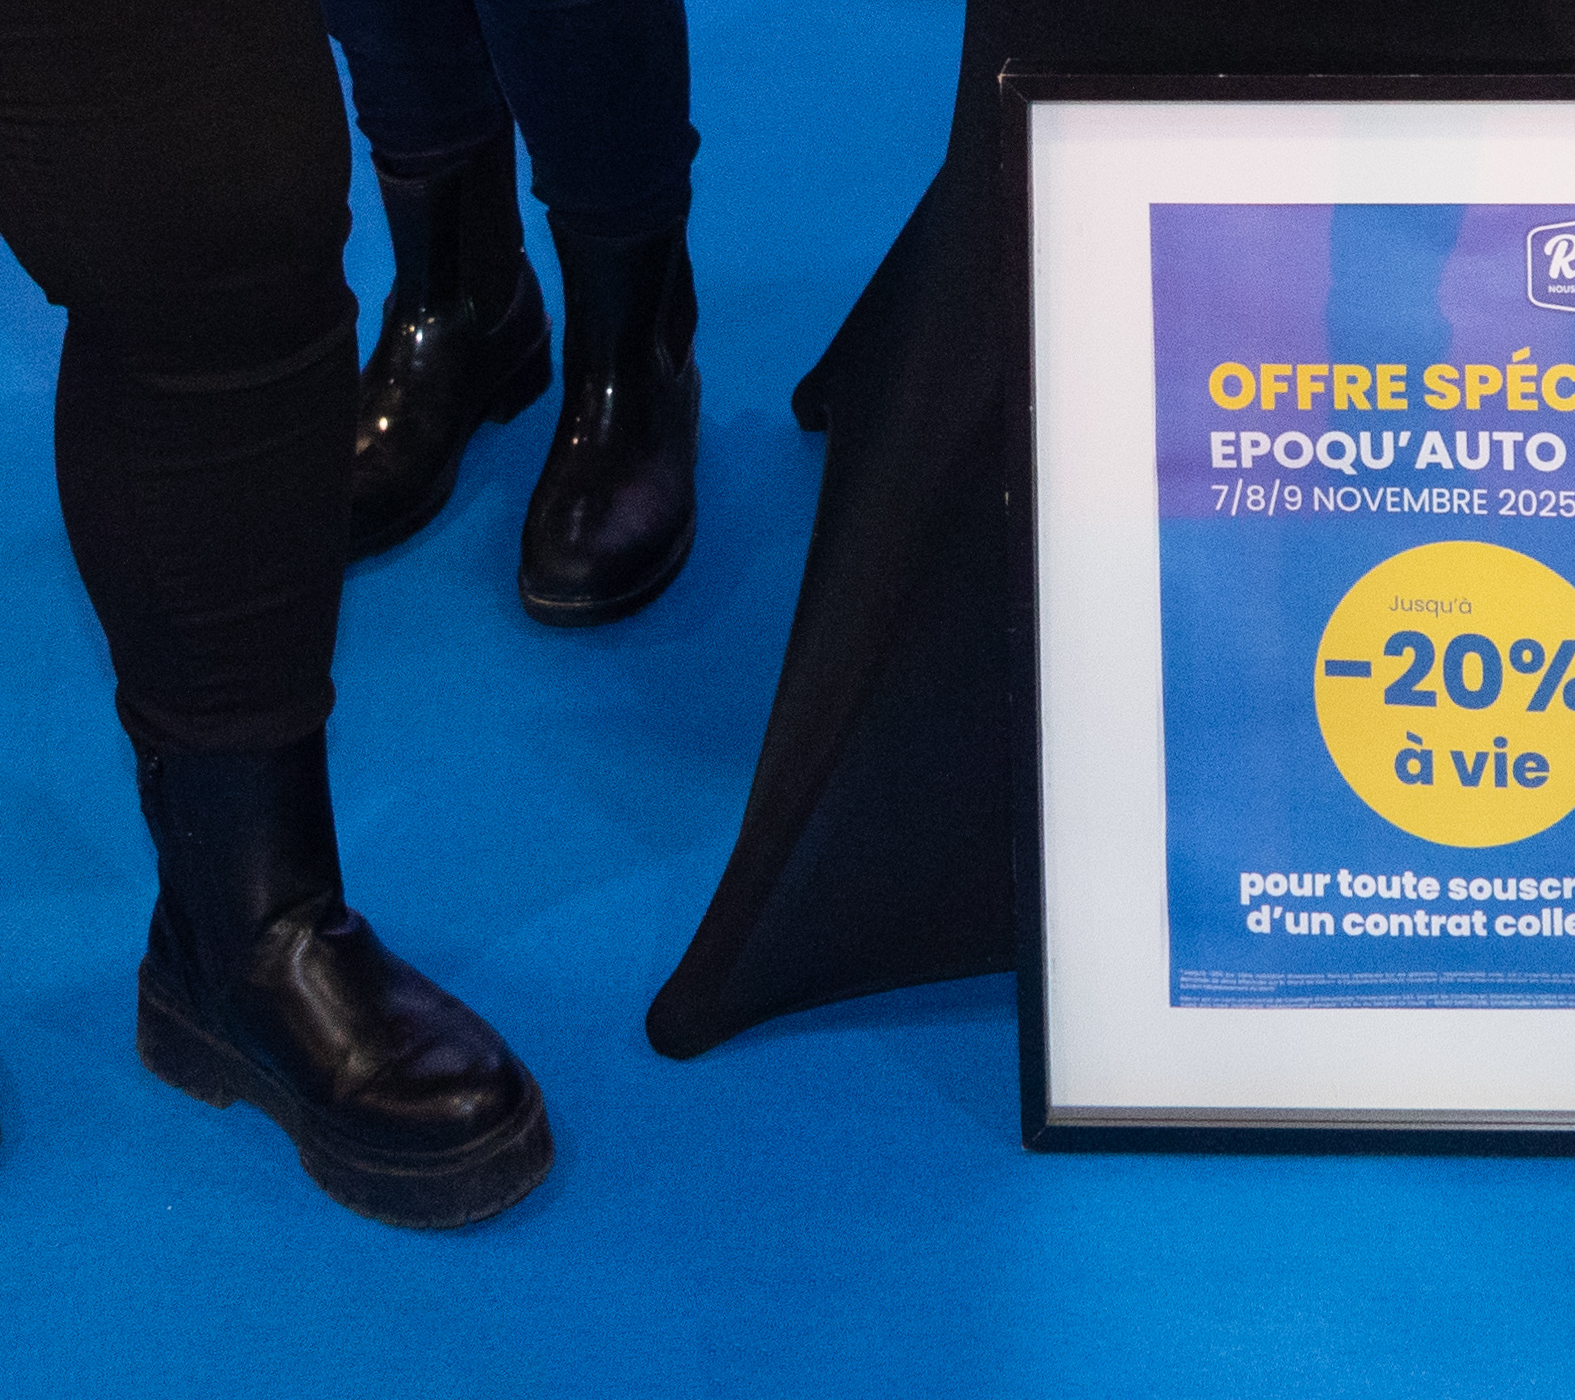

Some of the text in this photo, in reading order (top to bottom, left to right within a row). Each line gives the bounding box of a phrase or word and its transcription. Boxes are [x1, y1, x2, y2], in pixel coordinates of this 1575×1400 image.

[1548, 284, 1575, 294] NOUS
[1209, 361, 1408, 411] OFFRE
[1210, 429, 1567, 475] EPOQU'AUTO
[1210, 479, 1302, 516] 7/8/9
[1313, 485, 1489, 515] NOVEMBRE
[1394, 730, 1551, 789] à vie
[1240, 872, 1331, 905] pour
[1337, 869, 1441, 899] toute
[1247, 904, 1335, 936] d'un
[1342, 909, 1489, 936] contrat
